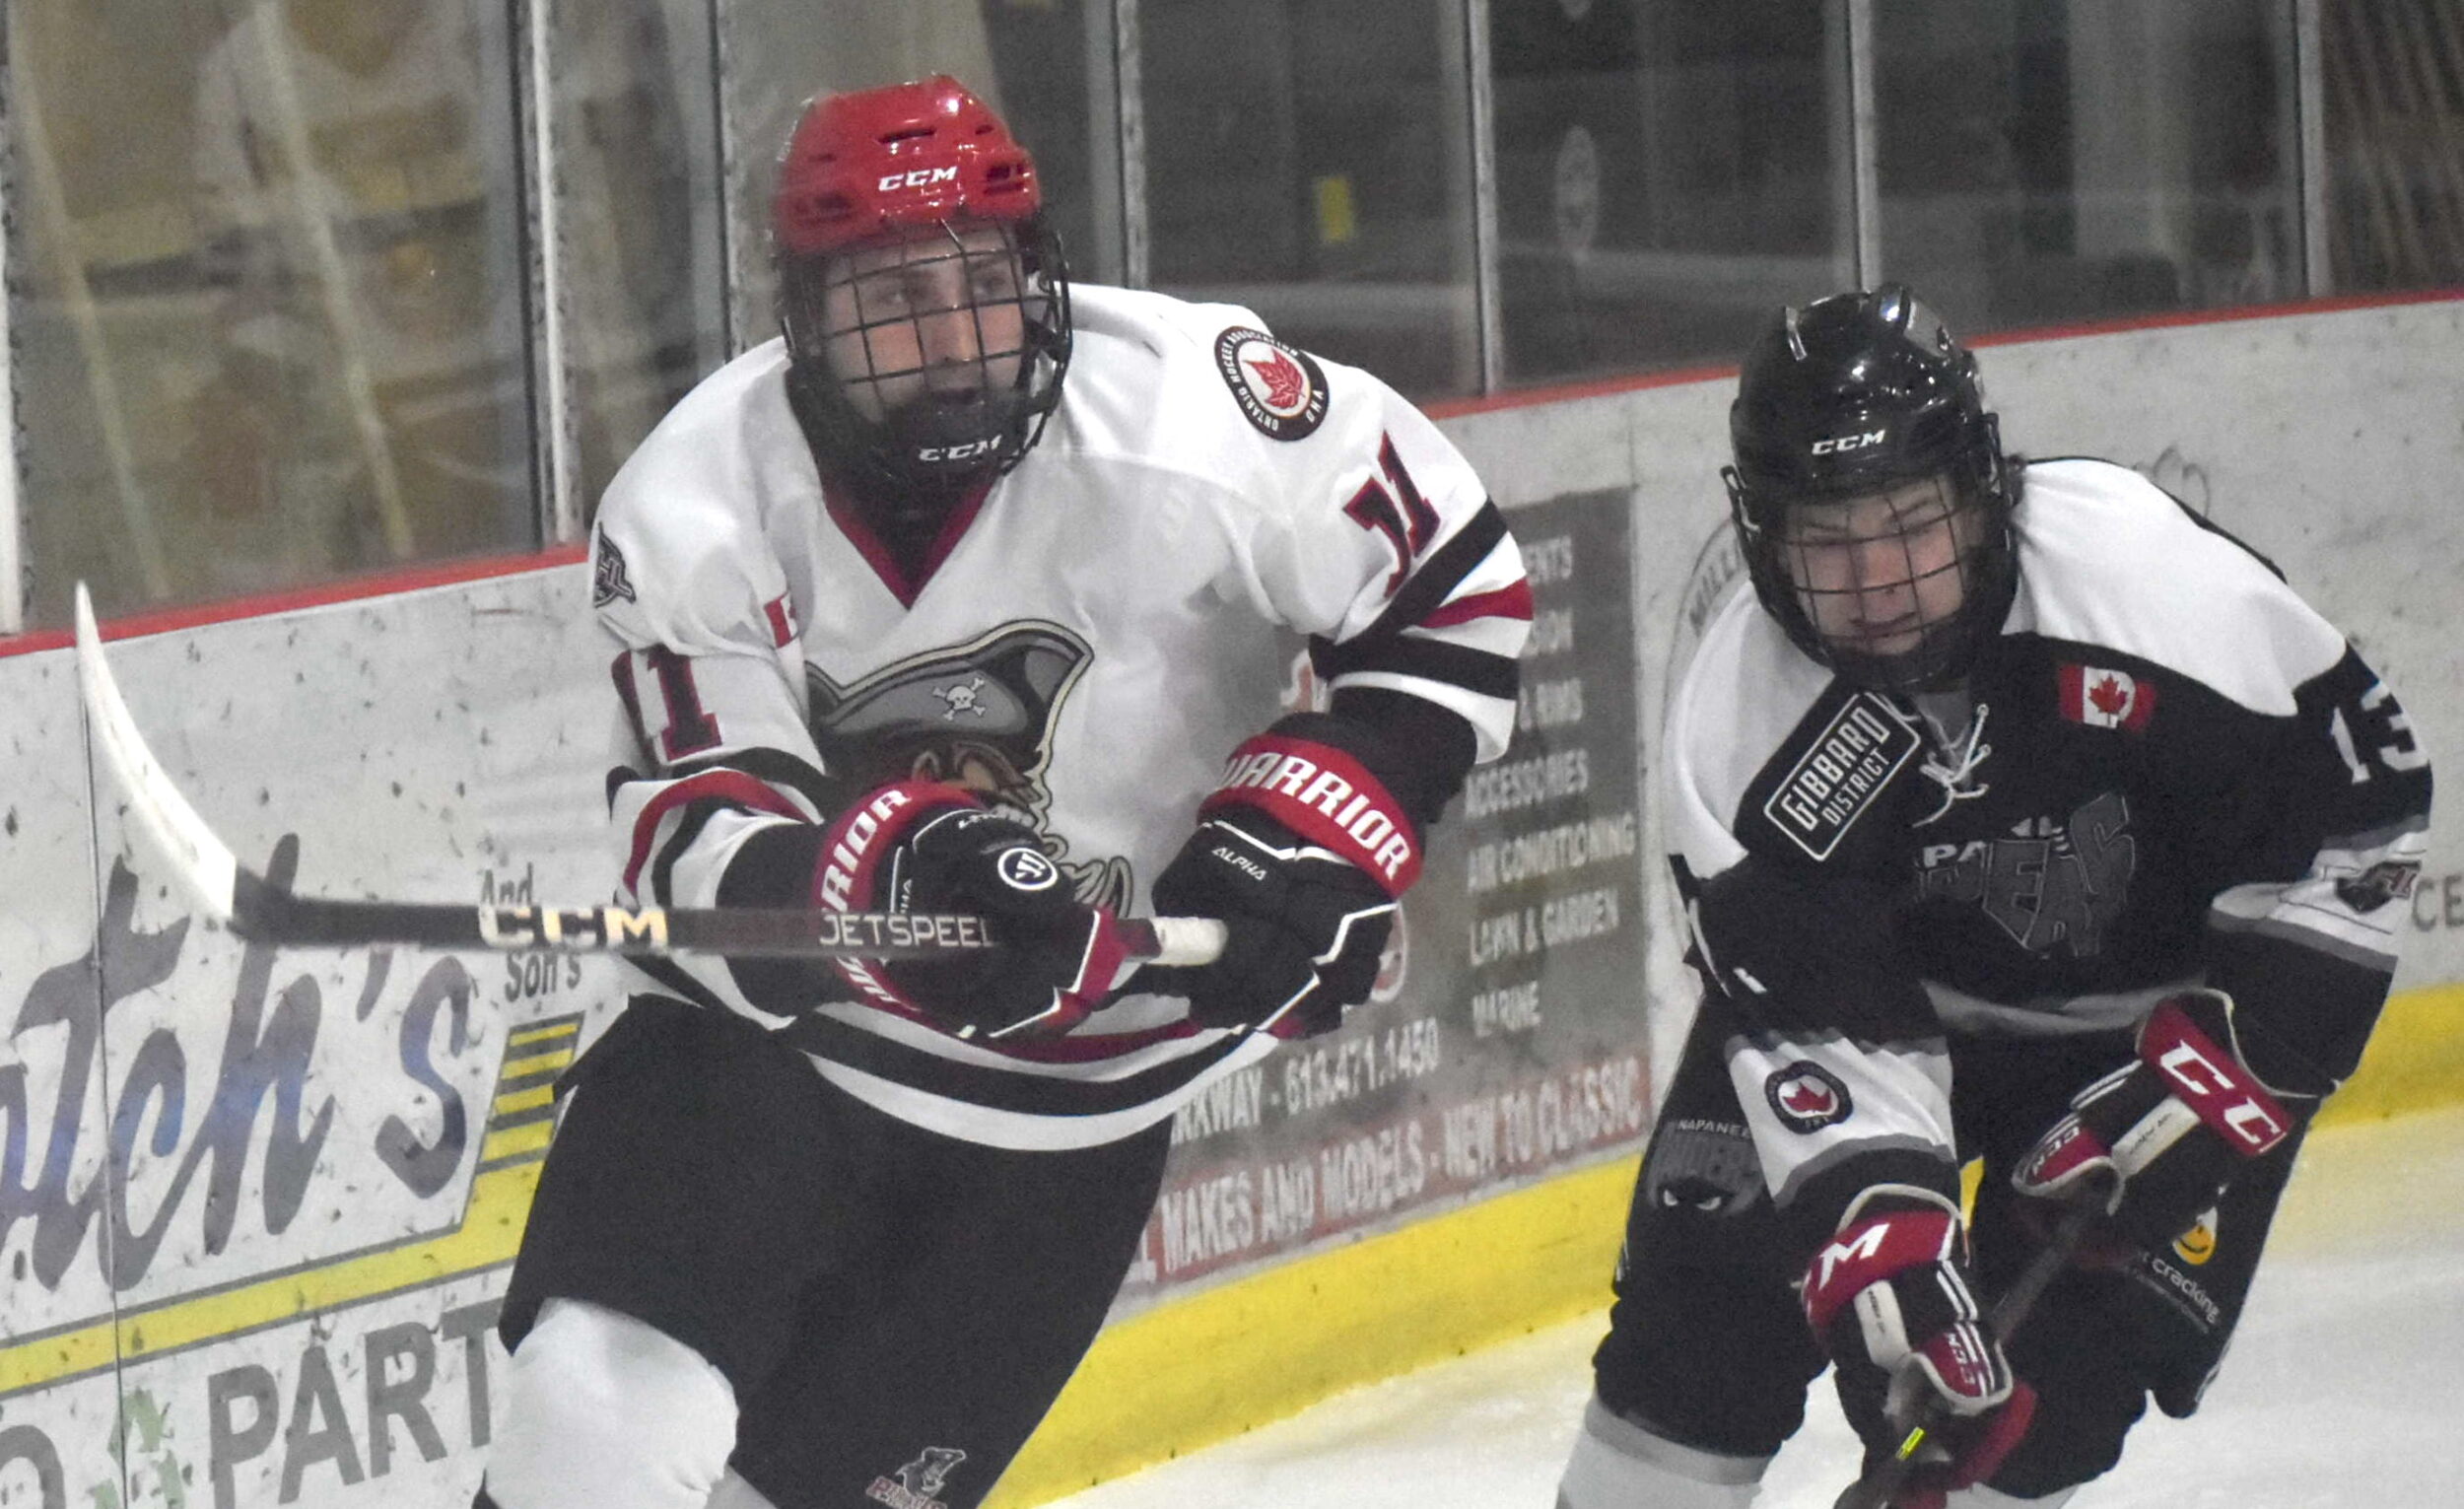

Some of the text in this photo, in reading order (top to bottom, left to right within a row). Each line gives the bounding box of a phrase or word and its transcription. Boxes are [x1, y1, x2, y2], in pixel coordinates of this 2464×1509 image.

[877, 166, 958, 193] CCM
[1238, 385, 1280, 432] ONTARIO
[918, 434, 1002, 462] CCM
[1812, 430, 1886, 456] CCM
[2330, 680, 2430, 785] 13
[1465, 747, 1590, 821] ACCESSORIES
[1780, 706, 1891, 832] GIBBARD
[1821, 746, 1890, 826] DISTRICT
[1211, 846, 1268, 882] ALPHA
[1500, 811, 1637, 884] CONDITIONING
[480, 860, 534, 906] And
[477, 904, 669, 953] CCM
[504, 950, 582, 1003] Son's
[2159, 1038, 2288, 1154] CC
[1160, 1169, 1255, 1273] MAKES
[1261, 1155, 1316, 1244] AND
[1321, 1120, 1426, 1222] MODELS
[1443, 1096, 1498, 1180] NEW
[1500, 1086, 1534, 1164] TO
[1538, 1054, 1643, 1157] CLASSIC
[2152, 1258, 2221, 1325] cracking
